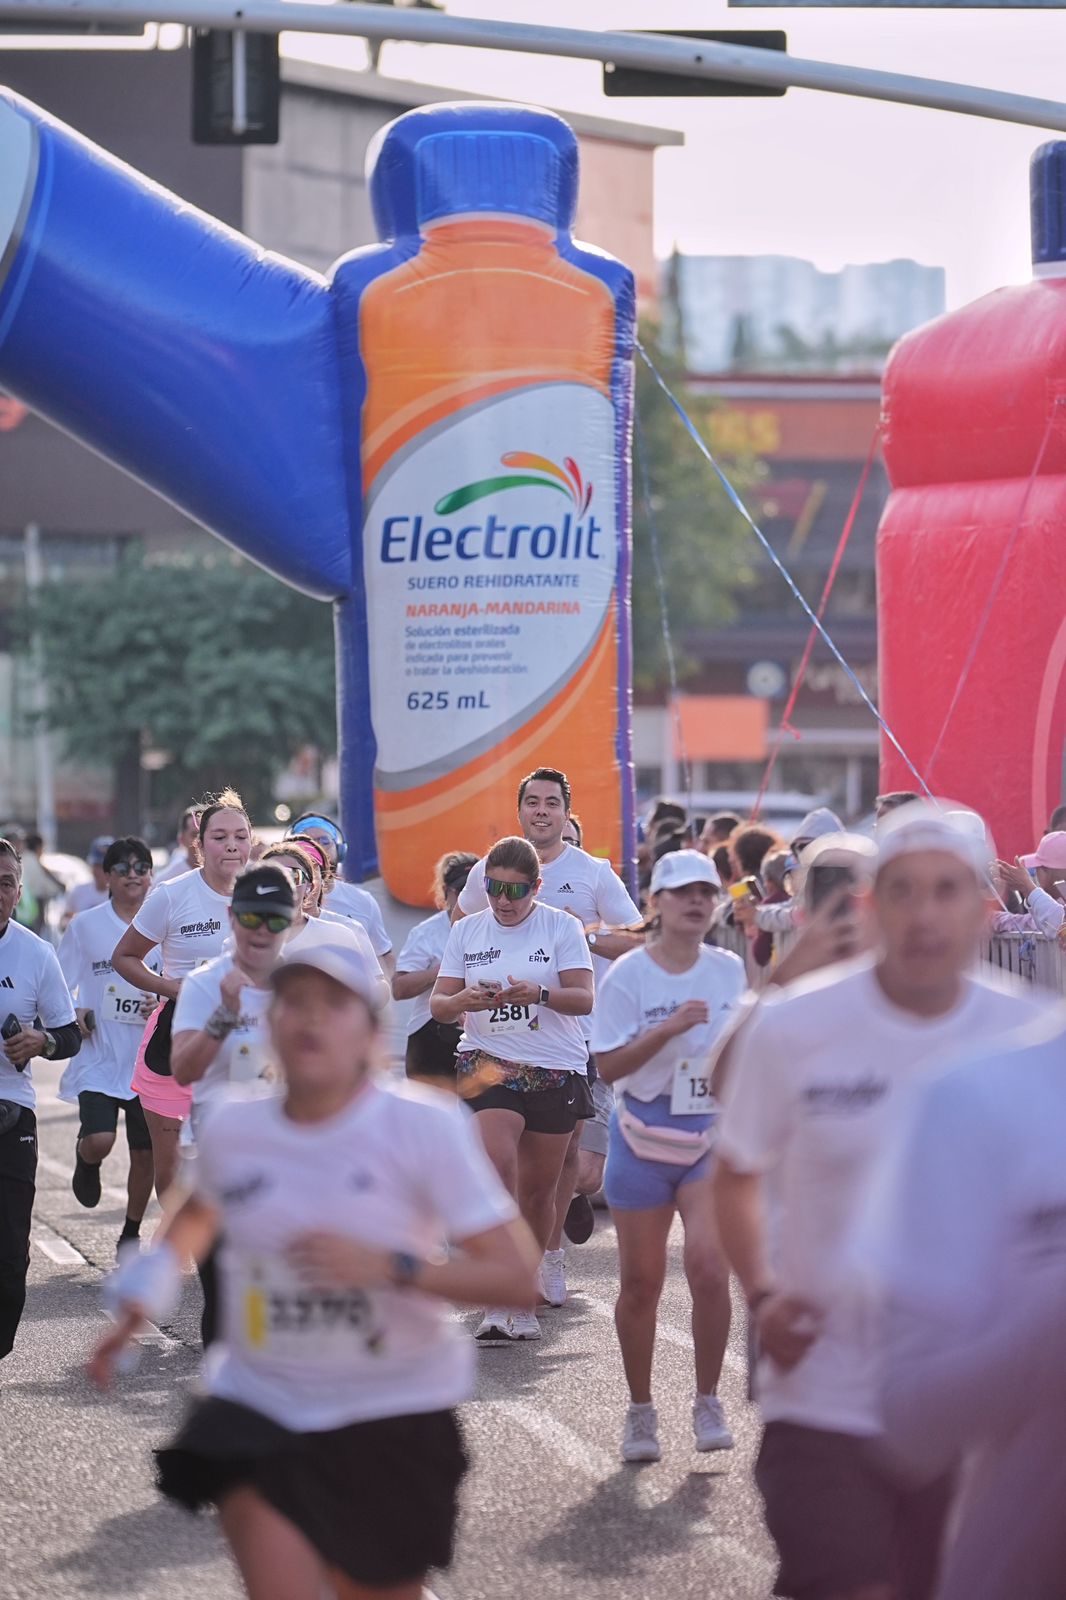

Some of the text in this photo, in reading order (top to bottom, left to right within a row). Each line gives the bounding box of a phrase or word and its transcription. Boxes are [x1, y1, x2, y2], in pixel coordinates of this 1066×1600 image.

[380, 513, 602, 563] Electrolit
[407, 573, 580, 590] SUERO REHIDRATANTE
[405, 601, 581, 619] NARANJA-MANDARINA
[405, 623, 520, 638] Solución esterilizada
[405, 638, 506, 650] de electrolitos orales
[446, 653, 469, 664] para
[442, 666, 452, 676] la
[407, 690, 491, 711] 625 mL
[529, 955, 543, 963] ERI
[488, 1004, 530, 1023] 2581
